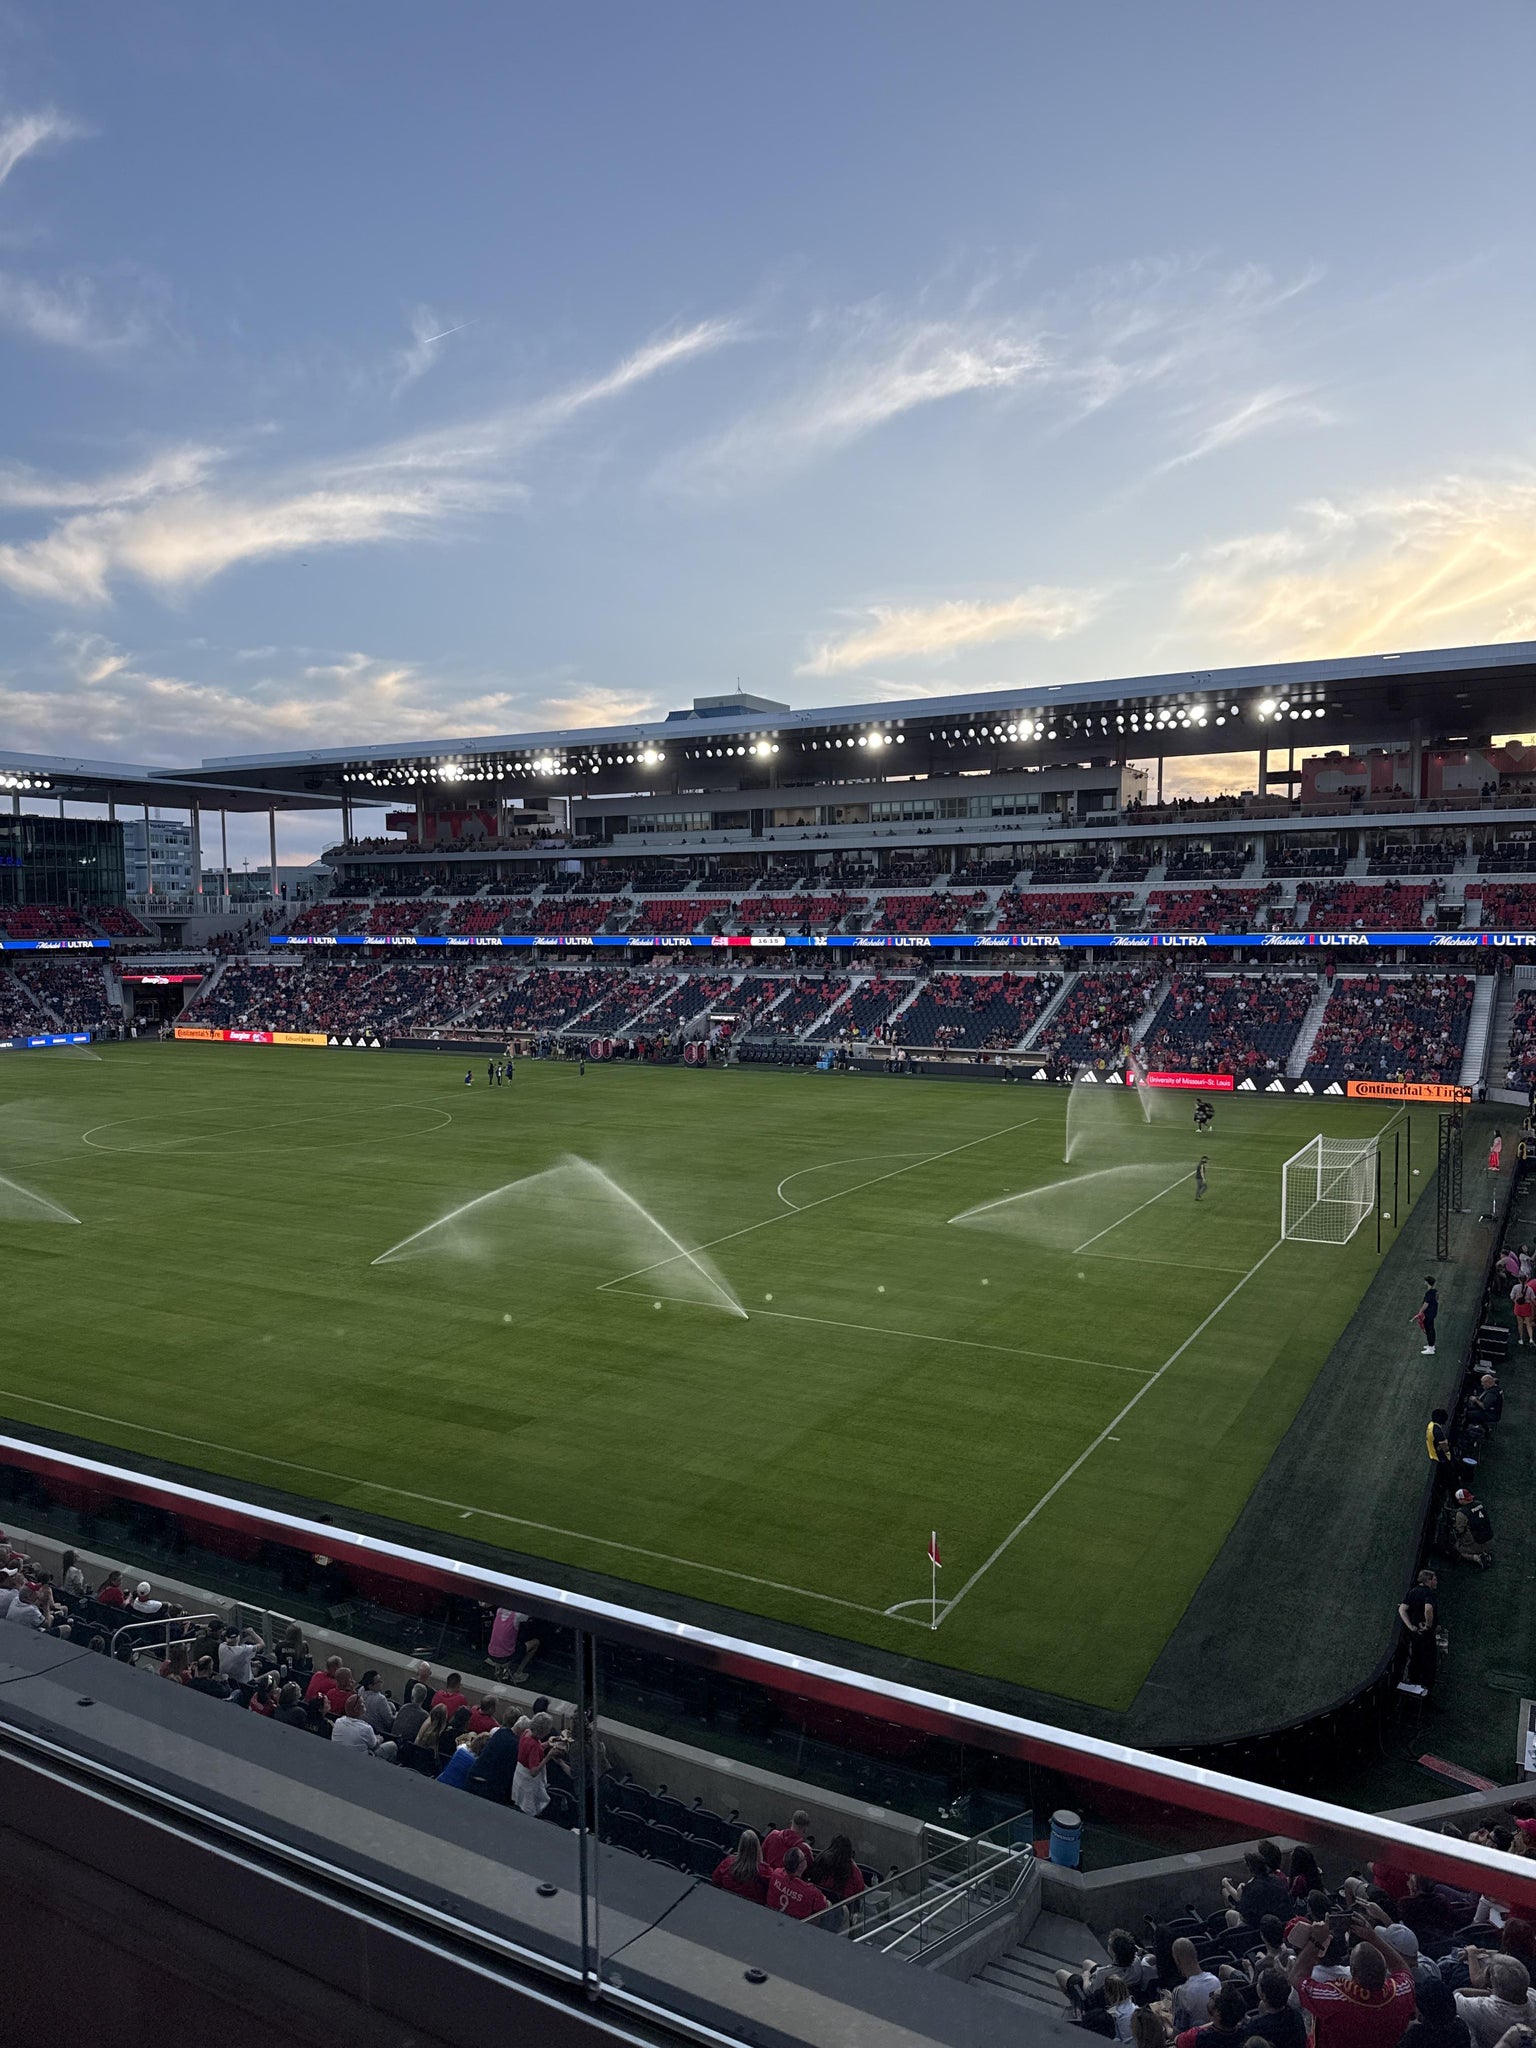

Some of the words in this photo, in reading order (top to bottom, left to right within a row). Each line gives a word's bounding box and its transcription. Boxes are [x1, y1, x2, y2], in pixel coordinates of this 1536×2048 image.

[67, 940, 94, 948] ULTRA
[895, 937, 931, 945] ULTRA
[1020, 937, 1061, 946] ULTRA
[1110, 936, 1151, 945] Michelob
[1162, 936, 1208, 945] ULTRA
[1260, 936, 1306, 945] Michelob
[1319, 936, 1370, 945] ULTRA
[1429, 935, 1478, 945] Michelob
[1149, 1076, 1175, 1085] University
[1216, 1079, 1231, 1087] Louis
[1355, 1082, 1423, 1097] Continental
[773, 1878, 805, 1903] KLAUSS
[779, 1893, 790, 1912] 9
